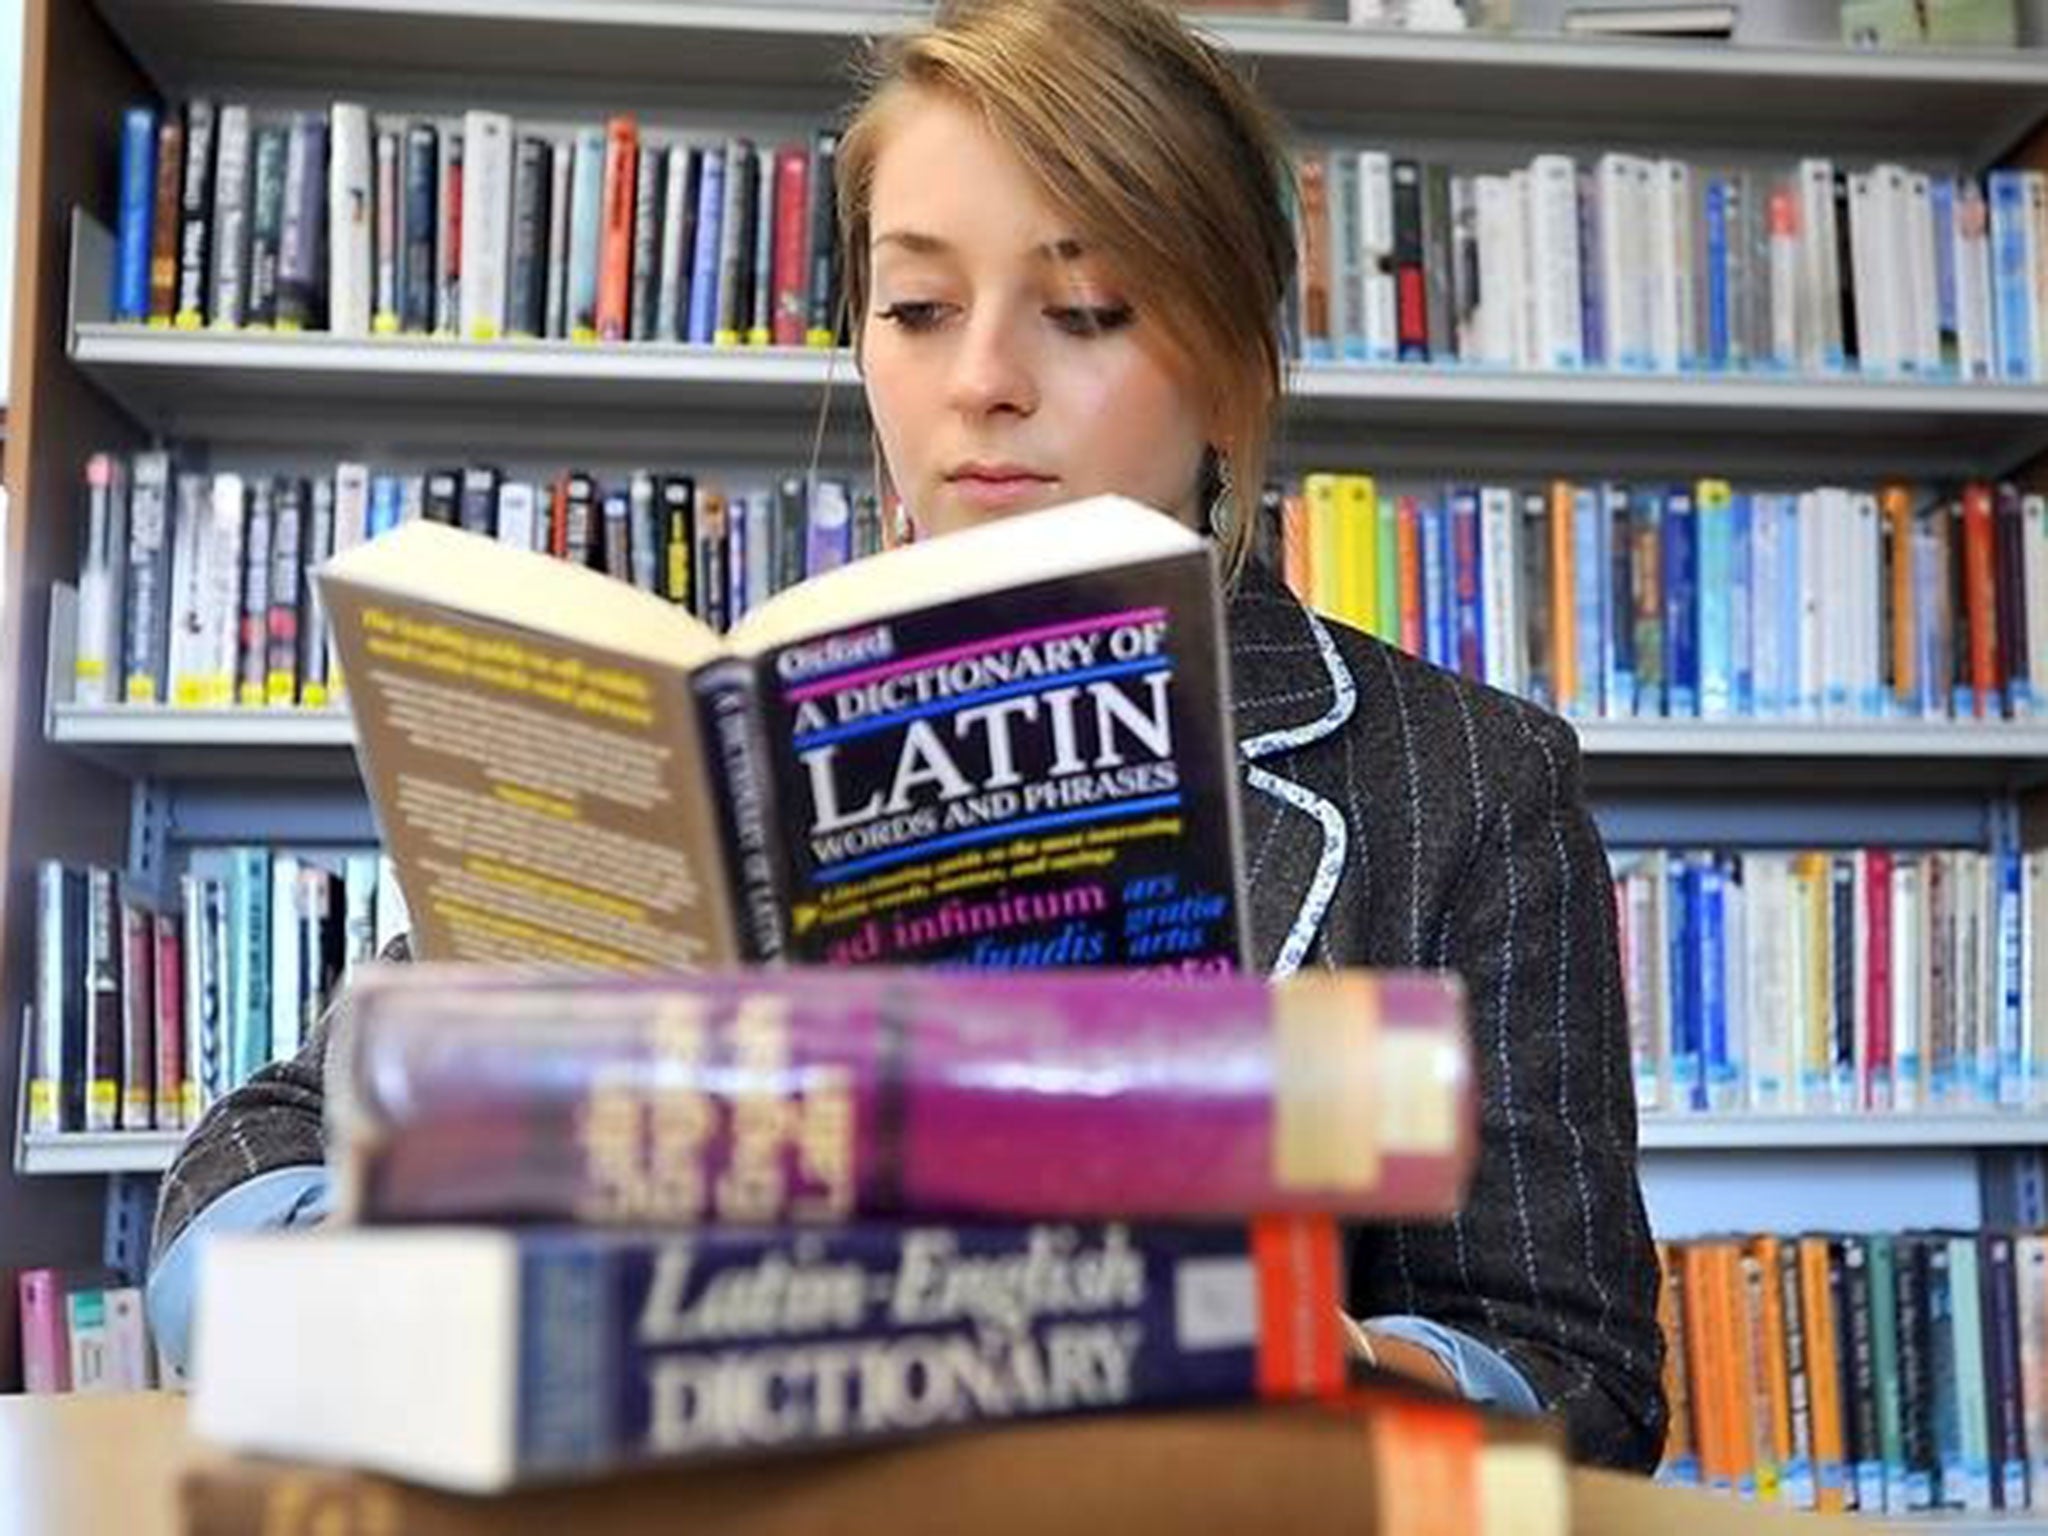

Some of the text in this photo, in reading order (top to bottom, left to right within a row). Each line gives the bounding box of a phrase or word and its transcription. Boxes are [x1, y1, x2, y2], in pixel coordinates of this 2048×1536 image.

[778, 627, 895, 680] Oxford
[795, 622, 1168, 732] A DICTIONARY OF
[800, 671, 1176, 833] LATIN
[811, 761, 1178, 864] WORDS AND PHRASES
[894, 885, 1106, 949] infinitum
[640, 1222, 1143, 1345] Latin-English
[650, 1320, 1137, 1455] DICTIONARY
